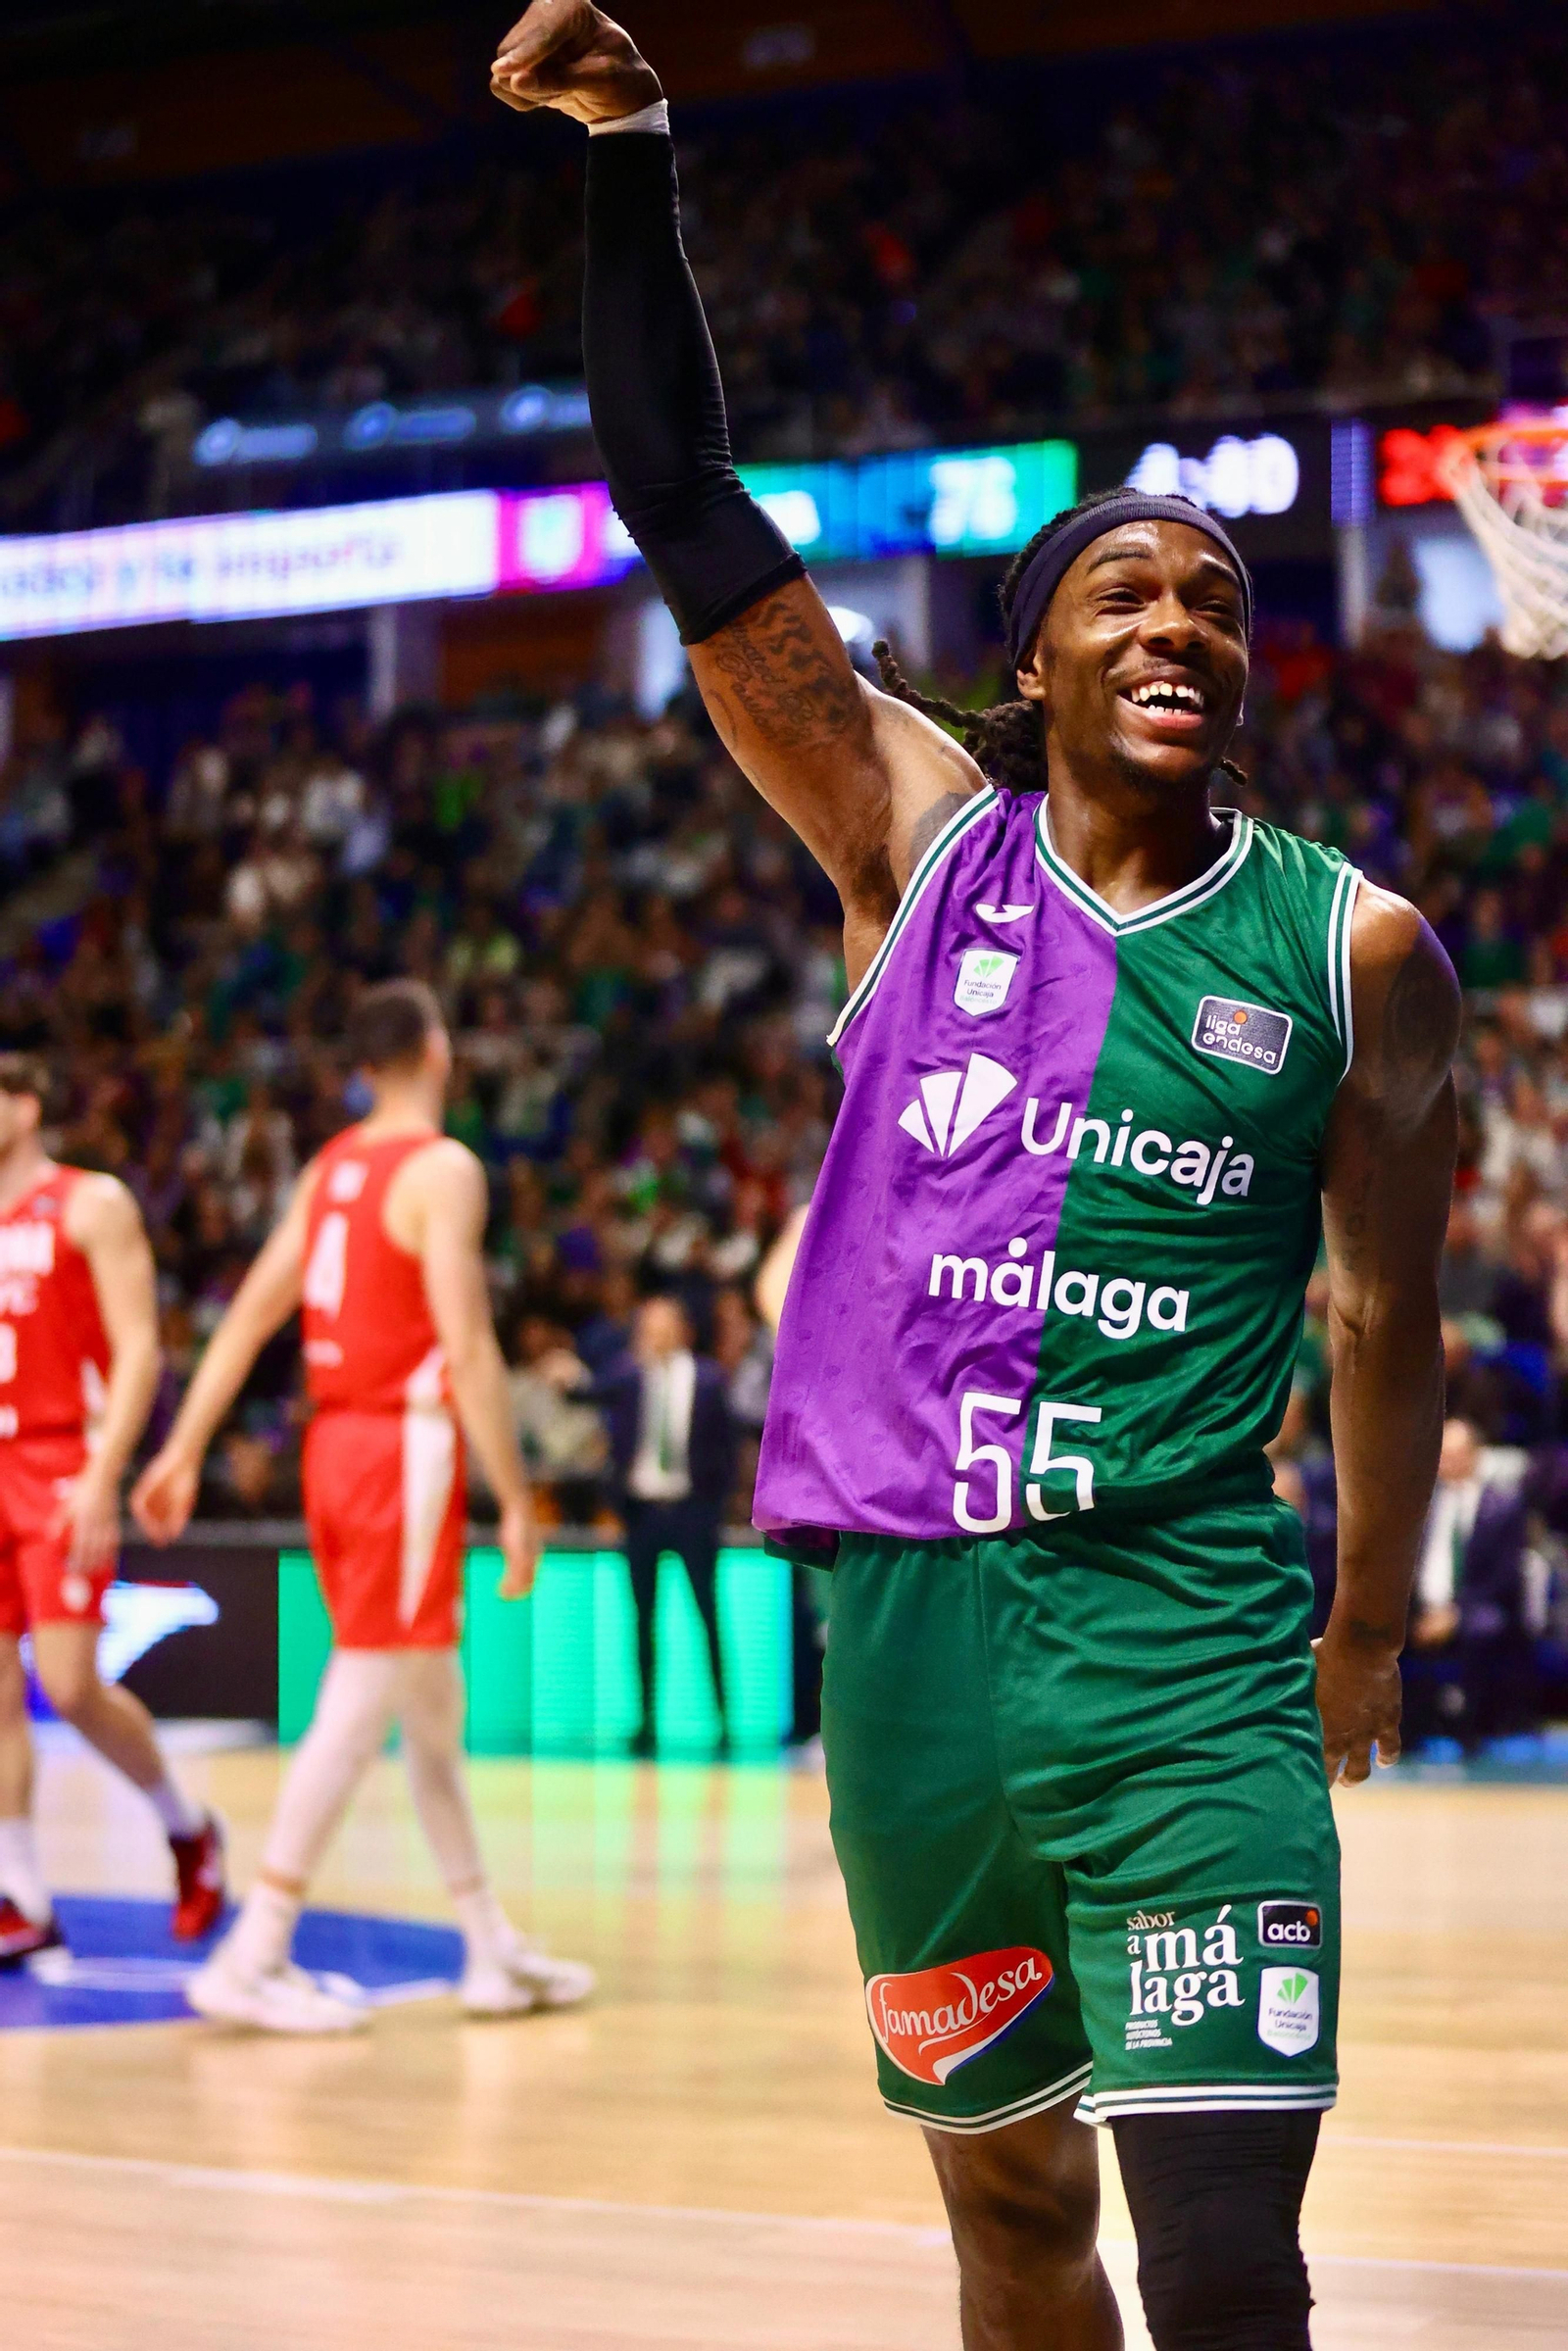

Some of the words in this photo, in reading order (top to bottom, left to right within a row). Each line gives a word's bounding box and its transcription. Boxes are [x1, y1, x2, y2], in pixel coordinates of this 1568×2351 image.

[963, 979, 1002, 991] Fundación
[966, 988, 995, 999] Unicaja
[1205, 1014, 1242, 1036] liga
[1202, 1032, 1277, 1065] endesa
[1020, 1097, 1255, 1205] Unicaja
[953, 1392, 1102, 1534] 55
[1127, 1910, 1175, 1931] sabor
[1267, 1921, 1311, 1942] acb
[1127, 1935, 1142, 1955] a
[1144, 1904, 1245, 1973] má
[1129, 1960, 1246, 2027] laga
